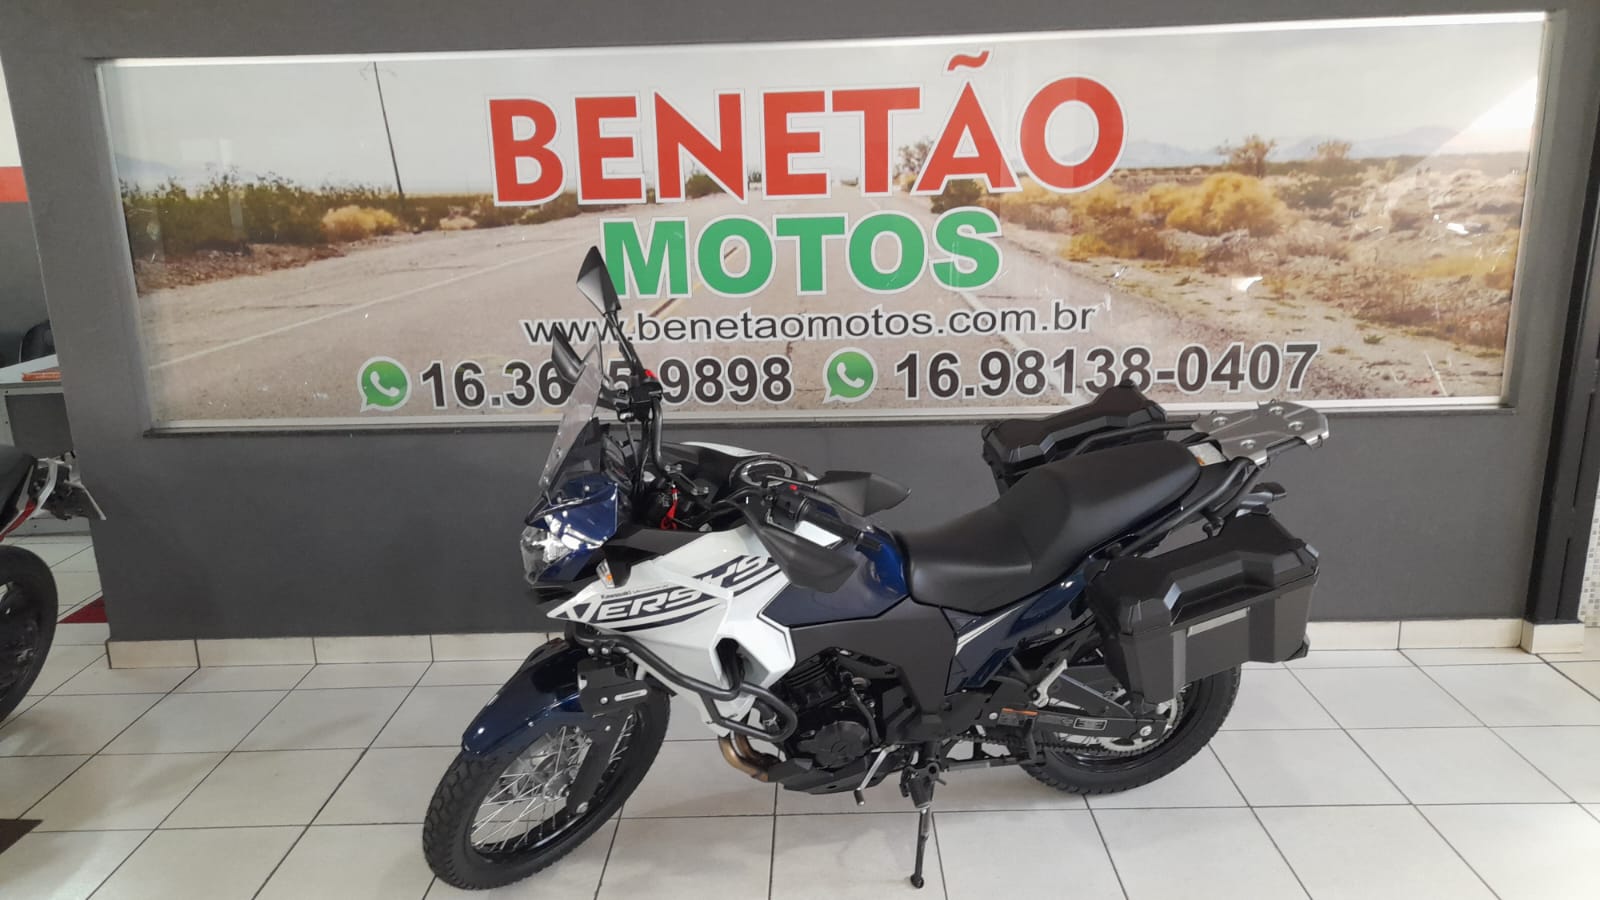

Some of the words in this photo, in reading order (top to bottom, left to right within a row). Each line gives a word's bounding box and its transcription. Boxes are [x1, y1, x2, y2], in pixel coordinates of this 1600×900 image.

[488, 51, 1125, 204] BENETÃO
[603, 211, 1002, 296] MOTOS
[523, 302, 1094, 343] www.benetaomotos.com.br
[421, 356, 793, 408] 16.3659898
[896, 344, 1318, 398] 16.98138-0407
